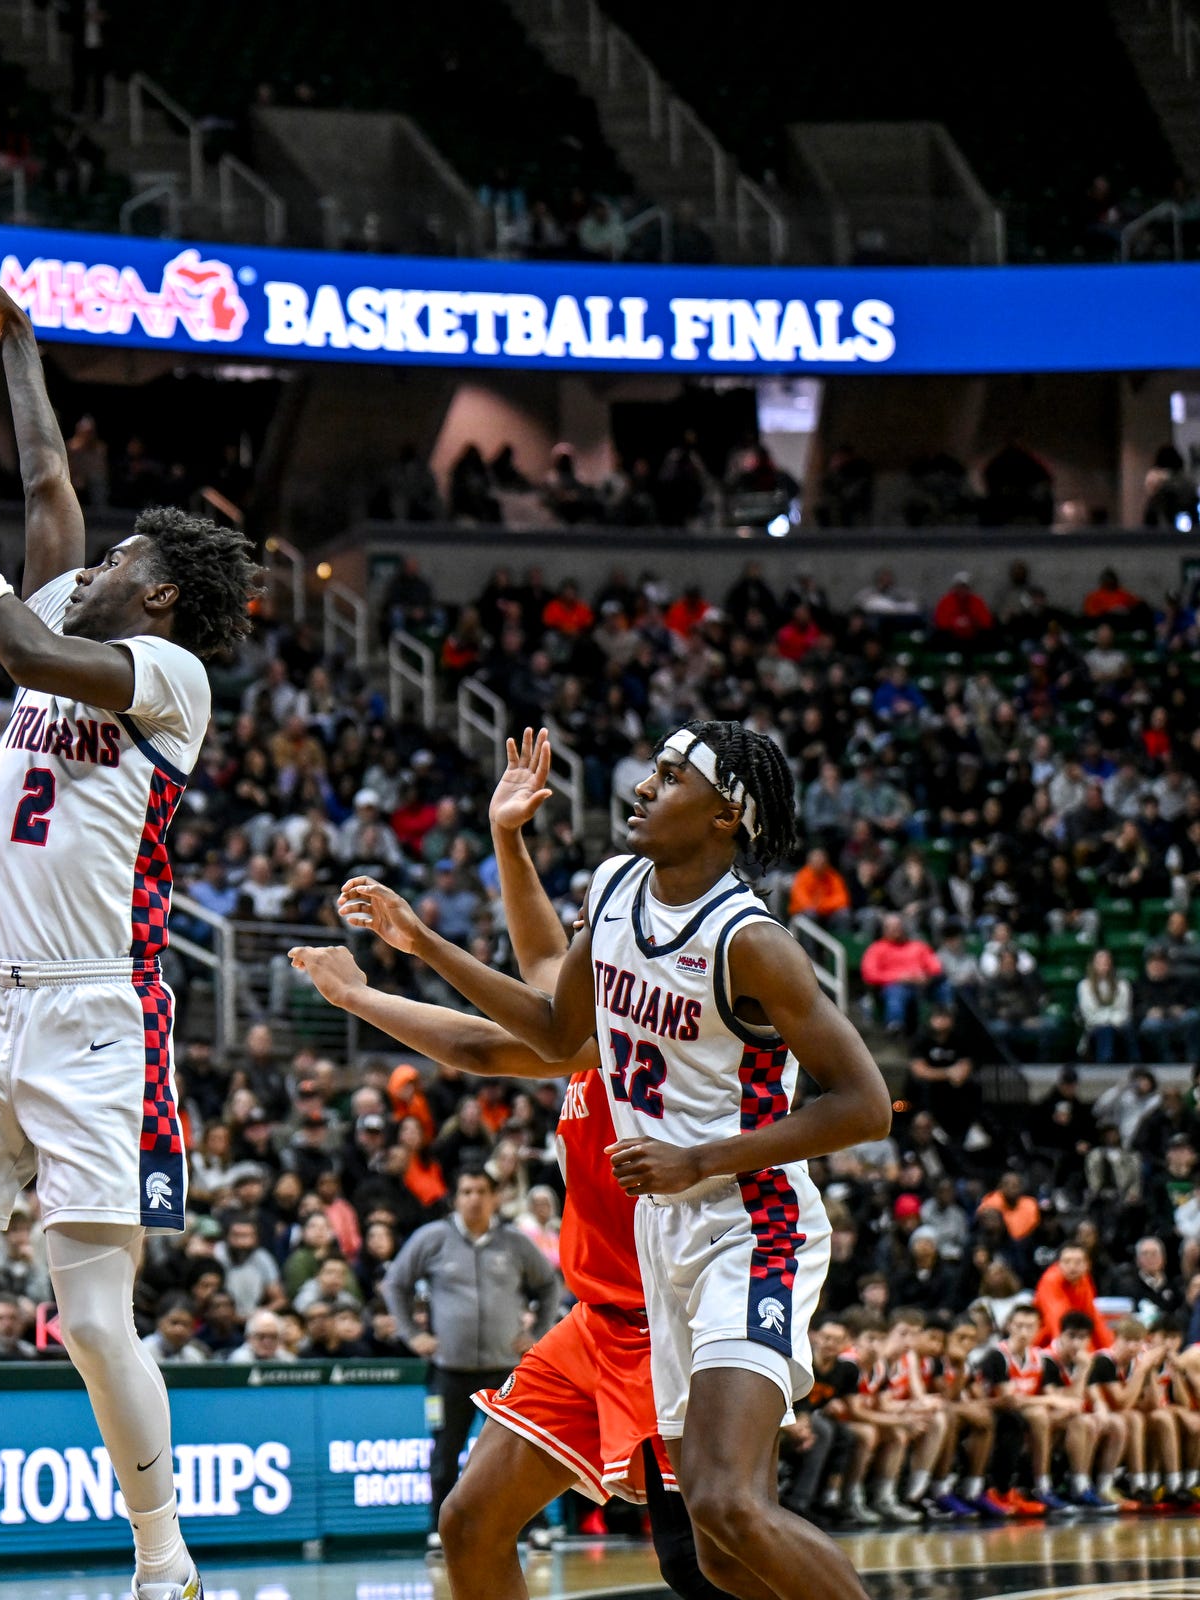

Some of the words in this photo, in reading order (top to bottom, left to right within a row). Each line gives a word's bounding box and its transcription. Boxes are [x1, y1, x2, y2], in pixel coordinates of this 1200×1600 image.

[264, 281, 664, 360] BASKETBALL
[670, 298, 896, 362] FINALS
[5, 705, 121, 768] TROJANS
[10, 767, 56, 847] 2
[594, 959, 702, 1042] TROJANS
[329, 1438, 435, 1473] BLOOMFI
[354, 1472, 432, 1507] BROTH
